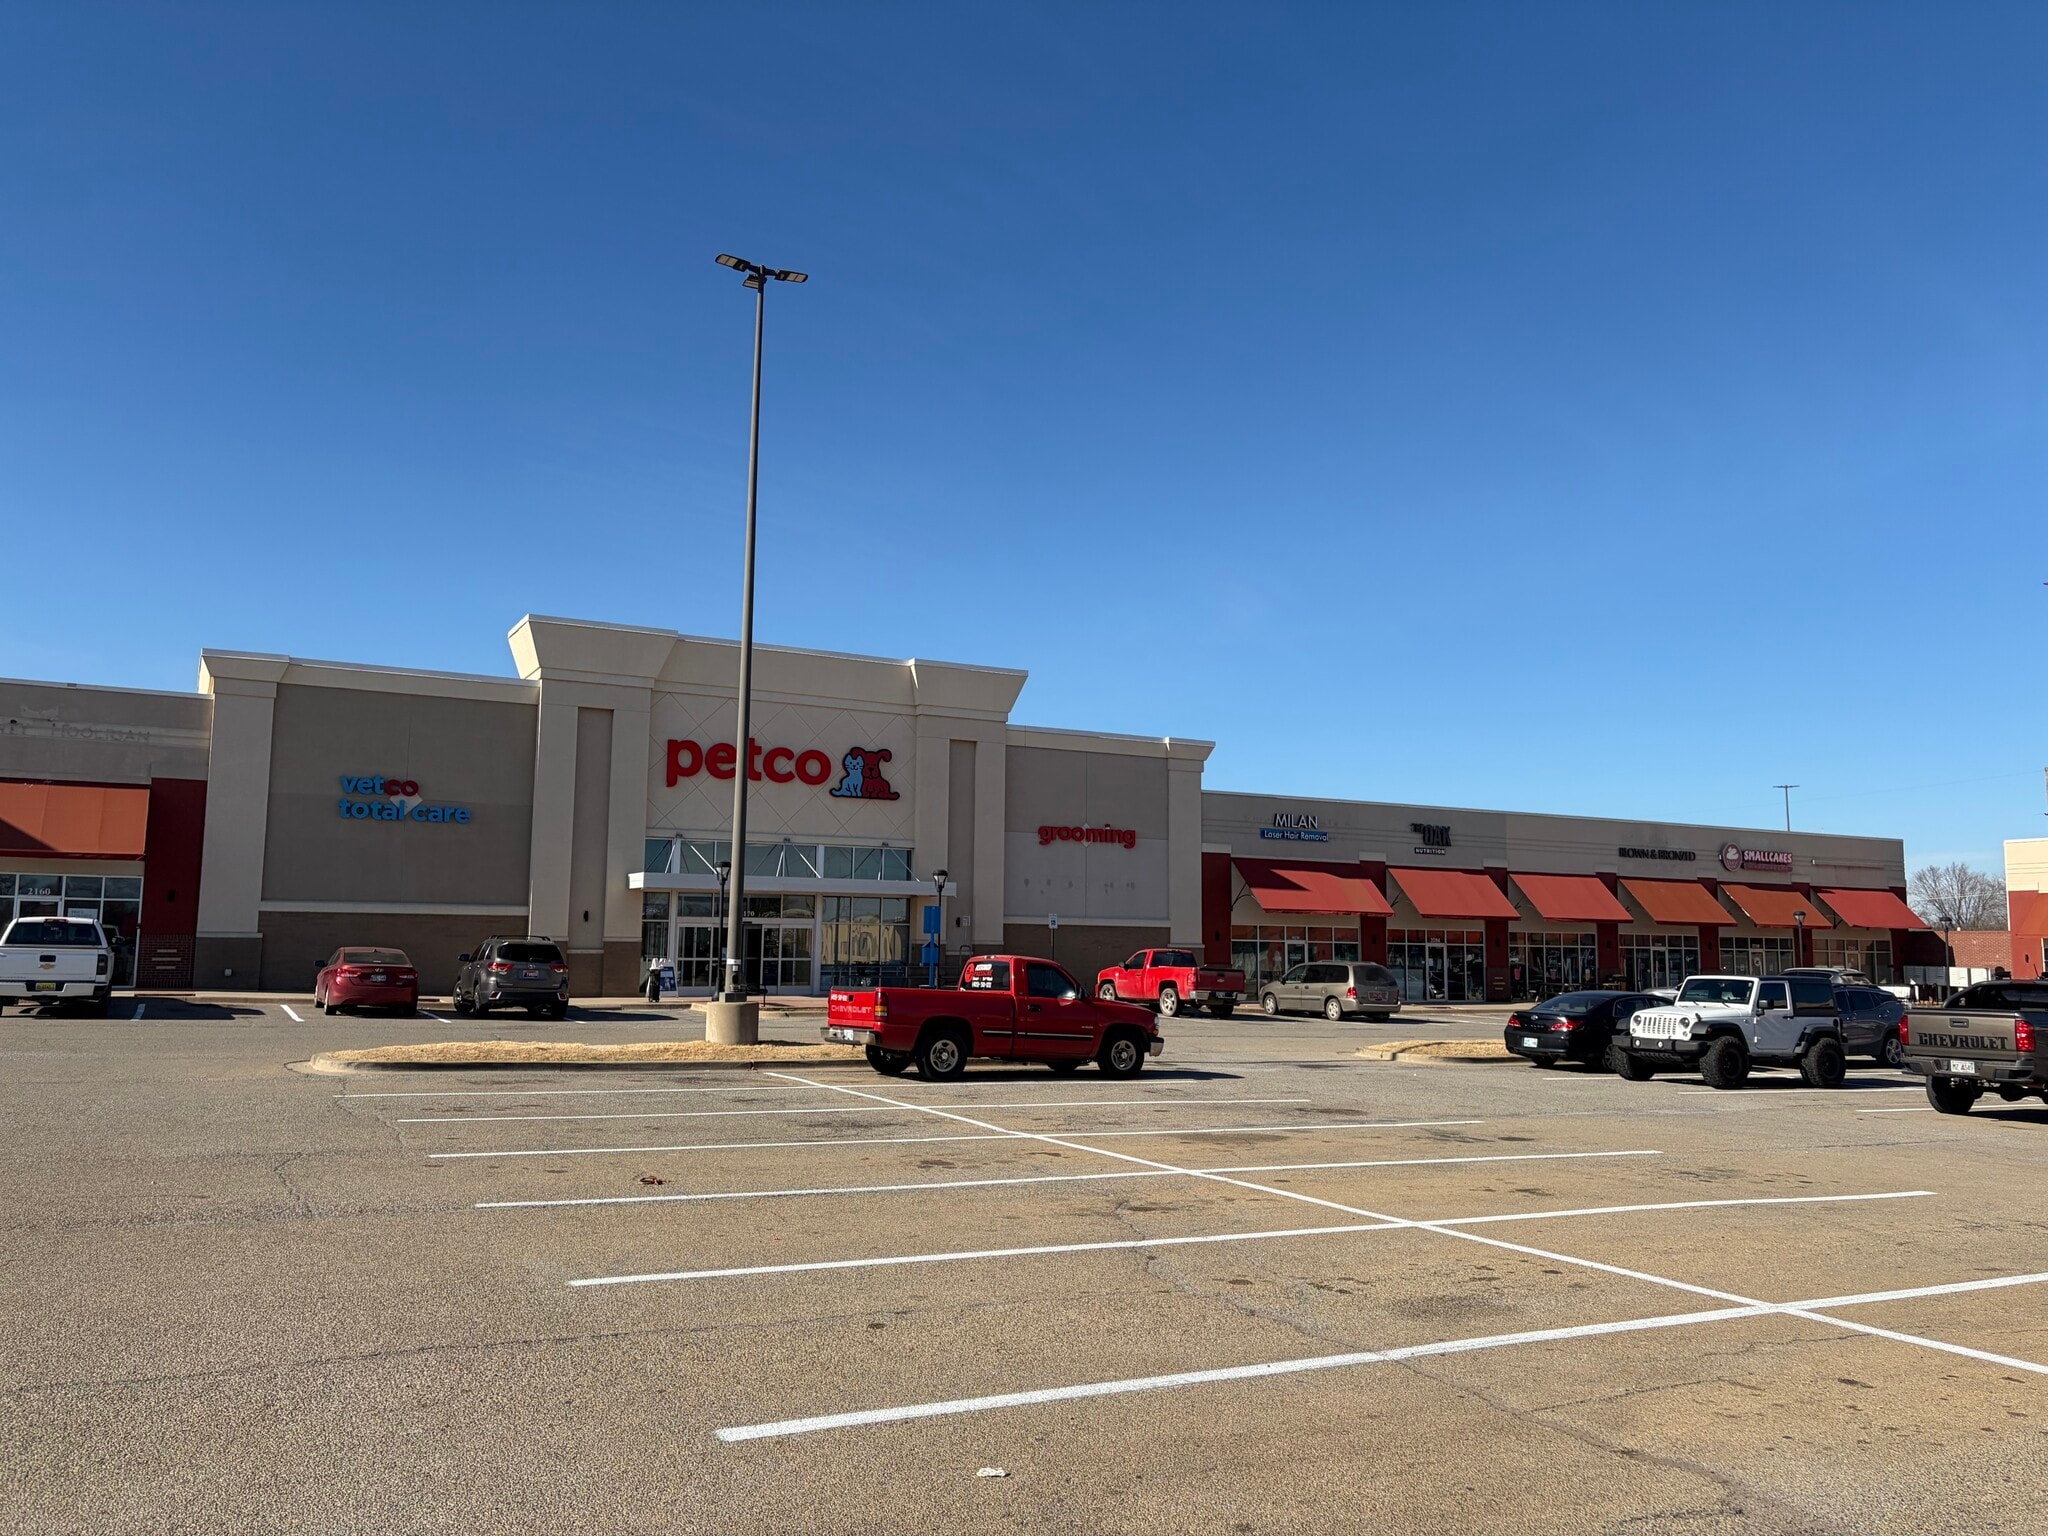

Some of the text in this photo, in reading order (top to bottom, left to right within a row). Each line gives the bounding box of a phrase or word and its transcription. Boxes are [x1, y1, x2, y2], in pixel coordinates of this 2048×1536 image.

[665, 737, 832, 787] petco
[340, 774, 419, 797] vetco
[339, 798, 472, 824] total care
[1274, 813, 1318, 829] MILAN
[1037, 824, 1136, 849] grooming
[1264, 830, 1329, 842] Laser Hair Removal
[1423, 824, 1452, 846] OAK
[1650, 849, 1657, 859] &
[1743, 850, 1792, 864] SMALLCAKES
[831, 1005, 872, 1014] CHEVROLET
[1917, 1033, 2009, 1050] CHEVROLET
